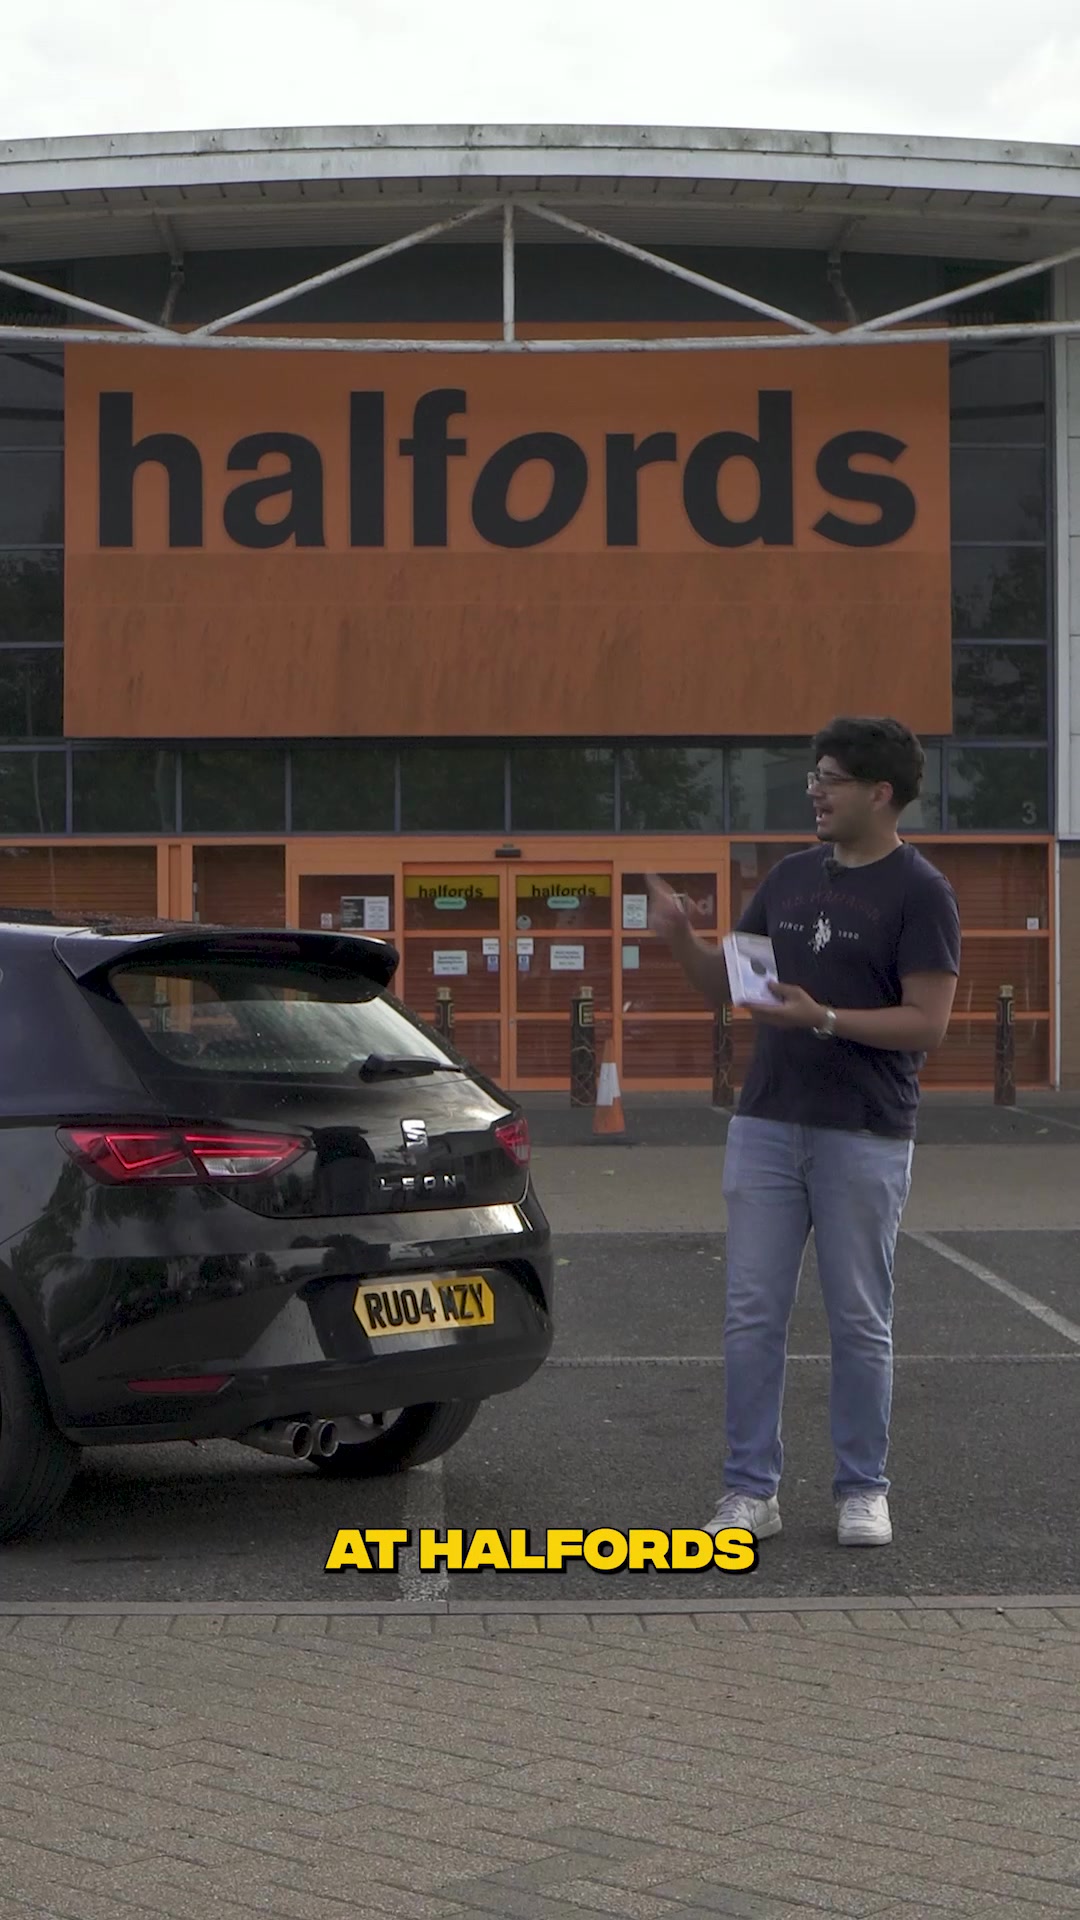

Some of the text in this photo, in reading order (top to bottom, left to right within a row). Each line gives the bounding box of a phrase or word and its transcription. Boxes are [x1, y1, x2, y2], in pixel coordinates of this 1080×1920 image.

[98, 388, 917, 549] halfords
[1022, 801, 1037, 825] 3
[418, 884, 484, 898] halfords
[531, 884, 597, 898] halfords
[380, 1175, 457, 1191] LEON
[363, 1287, 436, 1329] RU04
